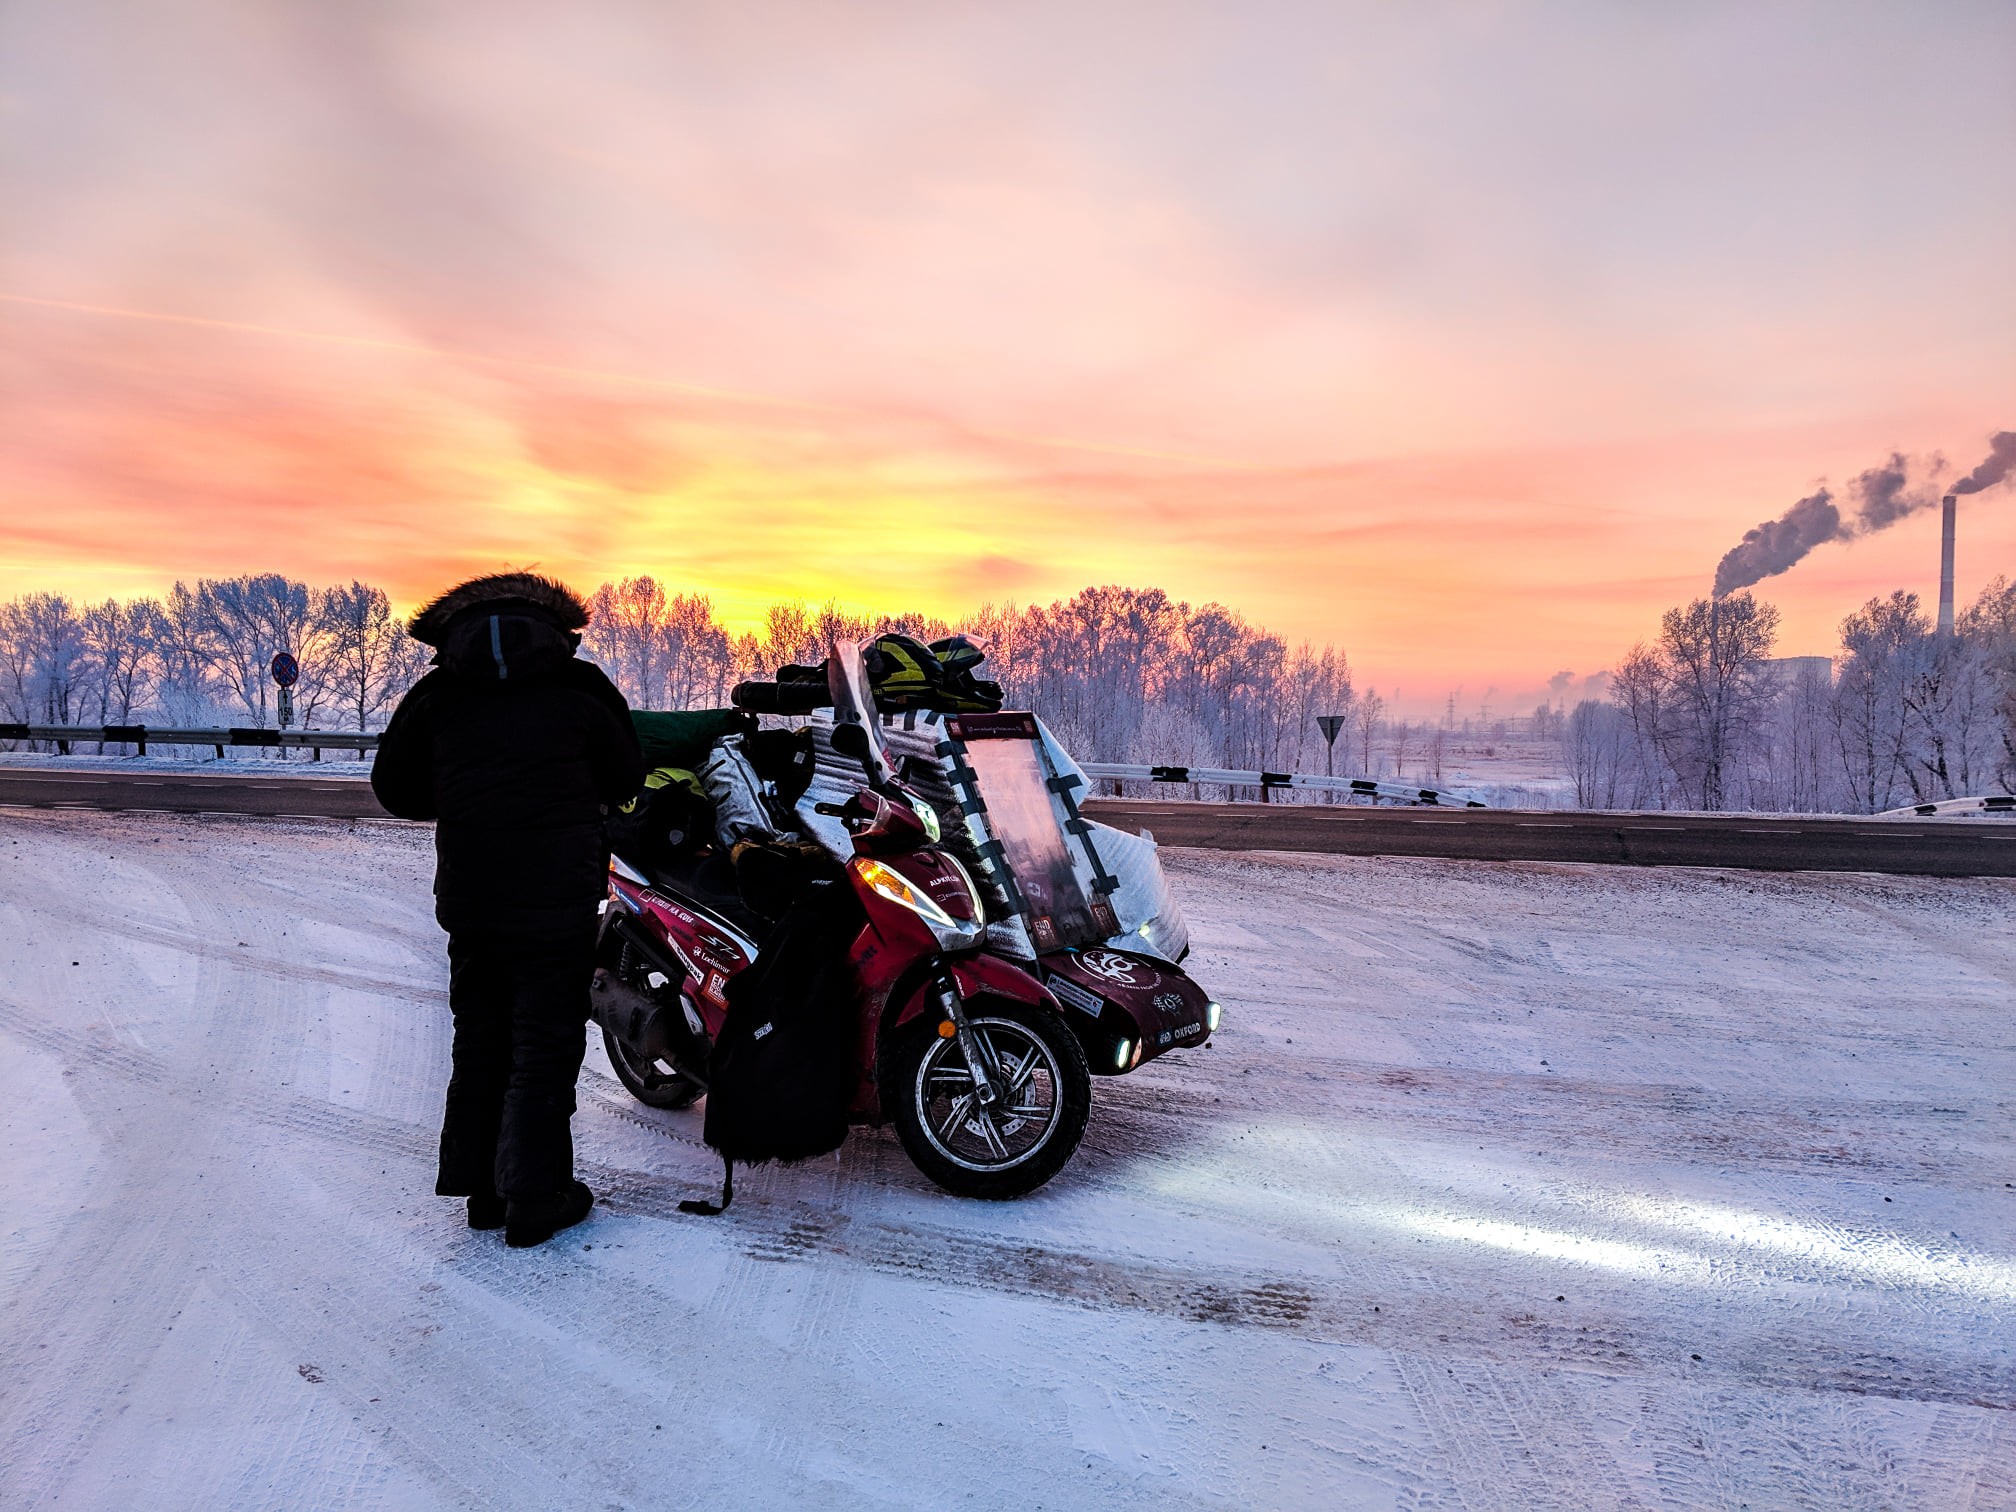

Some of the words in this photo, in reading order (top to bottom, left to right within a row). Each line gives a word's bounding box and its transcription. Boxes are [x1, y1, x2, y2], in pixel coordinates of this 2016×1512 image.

[280, 707, 292, 716] 150
[676, 946, 701, 981] Snugpak
[701, 952, 730, 974] Lochinvar
[711, 973, 727, 989] EN
[1174, 1022, 1201, 1039] OXFORD
